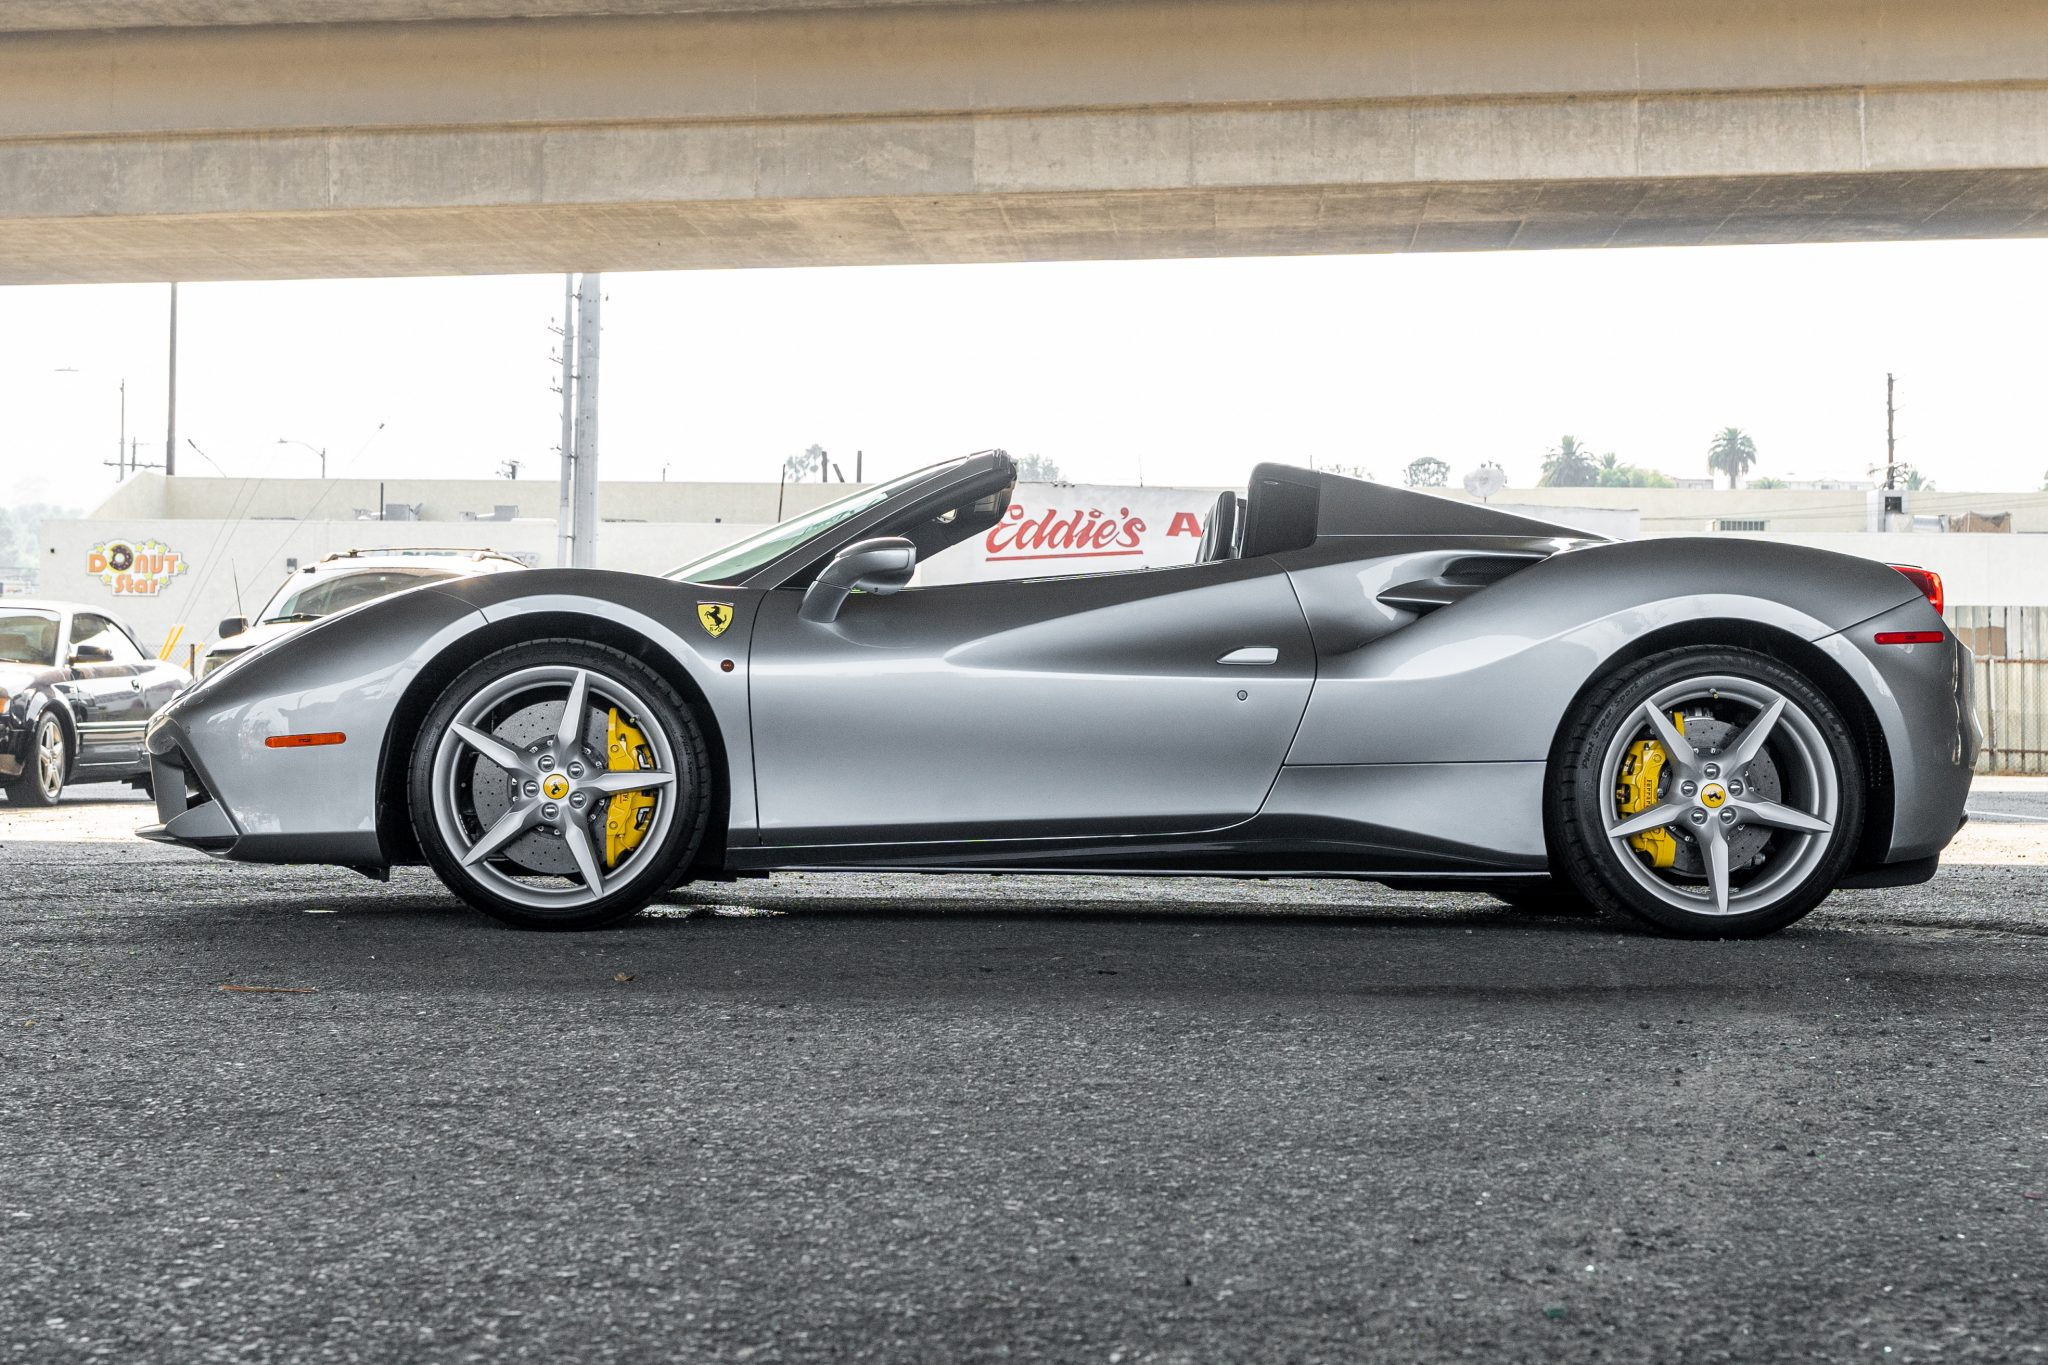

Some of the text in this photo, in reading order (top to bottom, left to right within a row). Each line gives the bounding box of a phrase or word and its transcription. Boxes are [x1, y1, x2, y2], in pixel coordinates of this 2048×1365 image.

[986, 504, 1147, 554] Eddie's
[115, 574, 158, 593] Star
[1581, 741, 1595, 769] Pilot
[1593, 709, 1612, 739] Super
[1614, 681, 1640, 707] Sport
